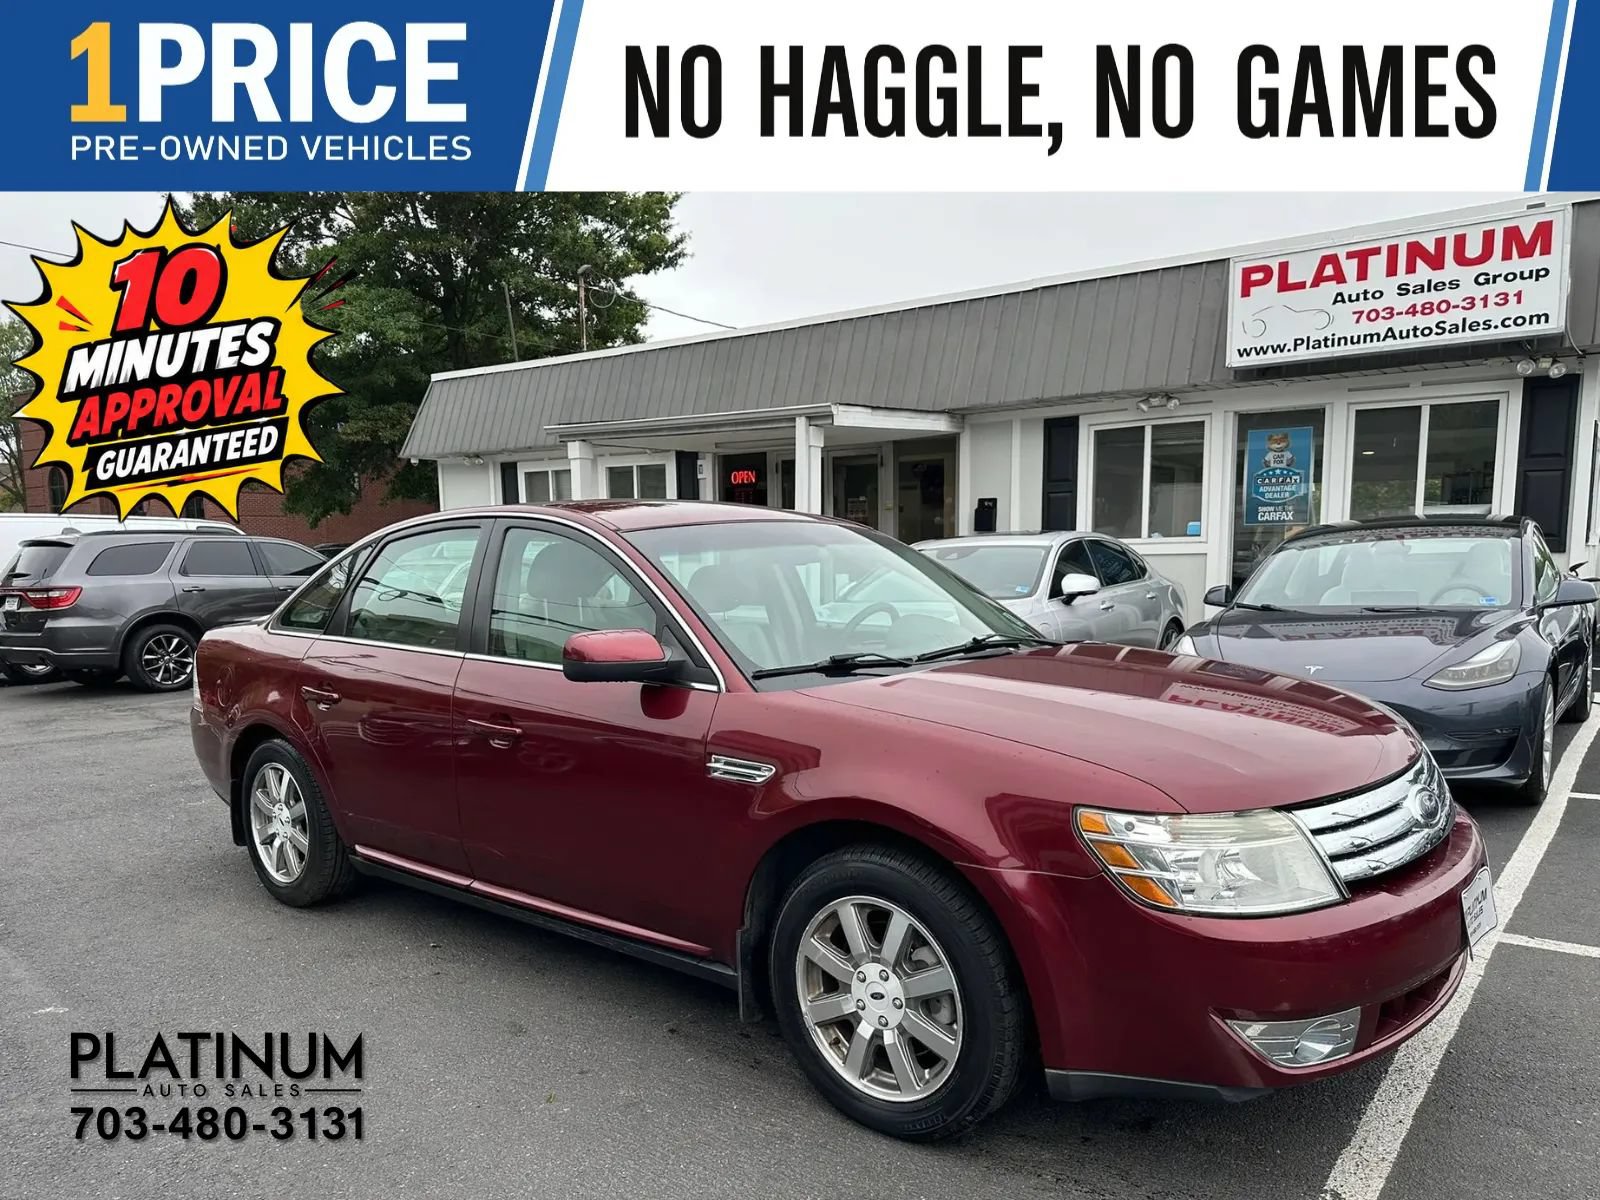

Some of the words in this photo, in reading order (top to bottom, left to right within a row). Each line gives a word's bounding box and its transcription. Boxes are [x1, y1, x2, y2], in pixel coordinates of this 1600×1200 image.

[1240, 219, 1554, 298] PLATINUM
[1332, 289, 1384, 306] Auto
[1396, 278, 1460, 297] Sales
[1473, 266, 1550, 287] Group
[1352, 289, 1524, 324] 703-480-3131
[1236, 310, 1550, 359] www.PlatinumAutoSales.com
[731, 470, 756, 484] OPEN
[1257, 476, 1300, 484] CARFAX
[1259, 484, 1297, 492] ADVANTAGE
[1264, 491, 1290, 499] DEALER
[1257, 511, 1294, 521] CARFAX
